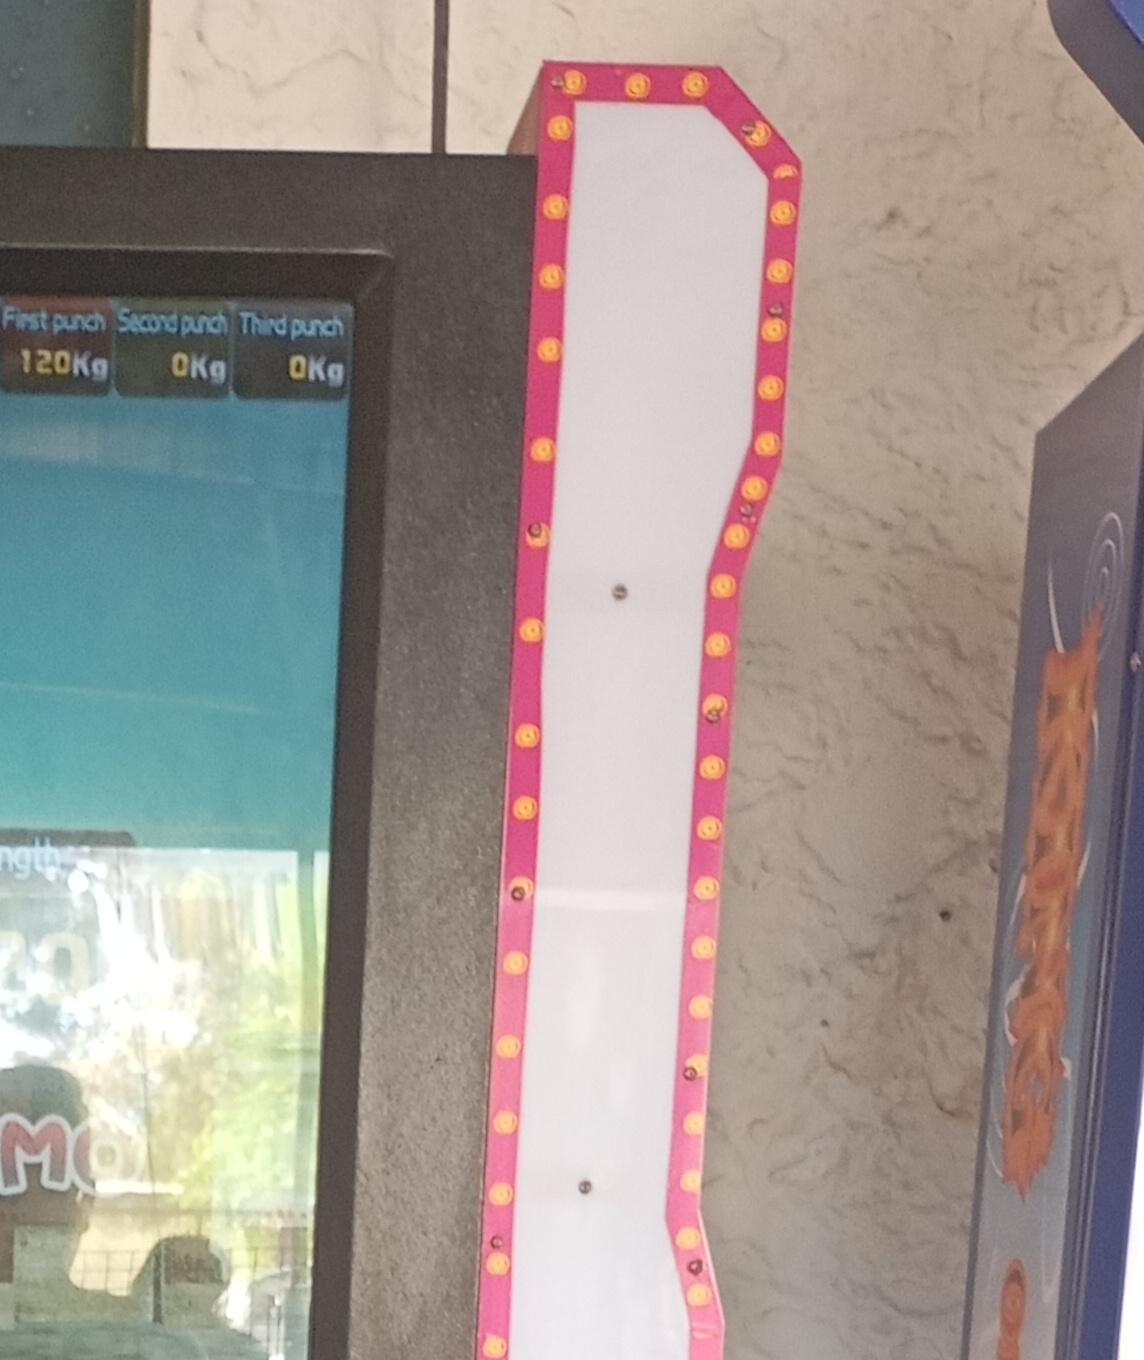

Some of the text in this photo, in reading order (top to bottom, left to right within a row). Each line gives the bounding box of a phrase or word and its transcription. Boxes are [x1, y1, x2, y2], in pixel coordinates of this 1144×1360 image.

[1, 305, 106, 336] First punch
[118, 307, 228, 338] Second punch
[239, 311, 344, 342] Third punch
